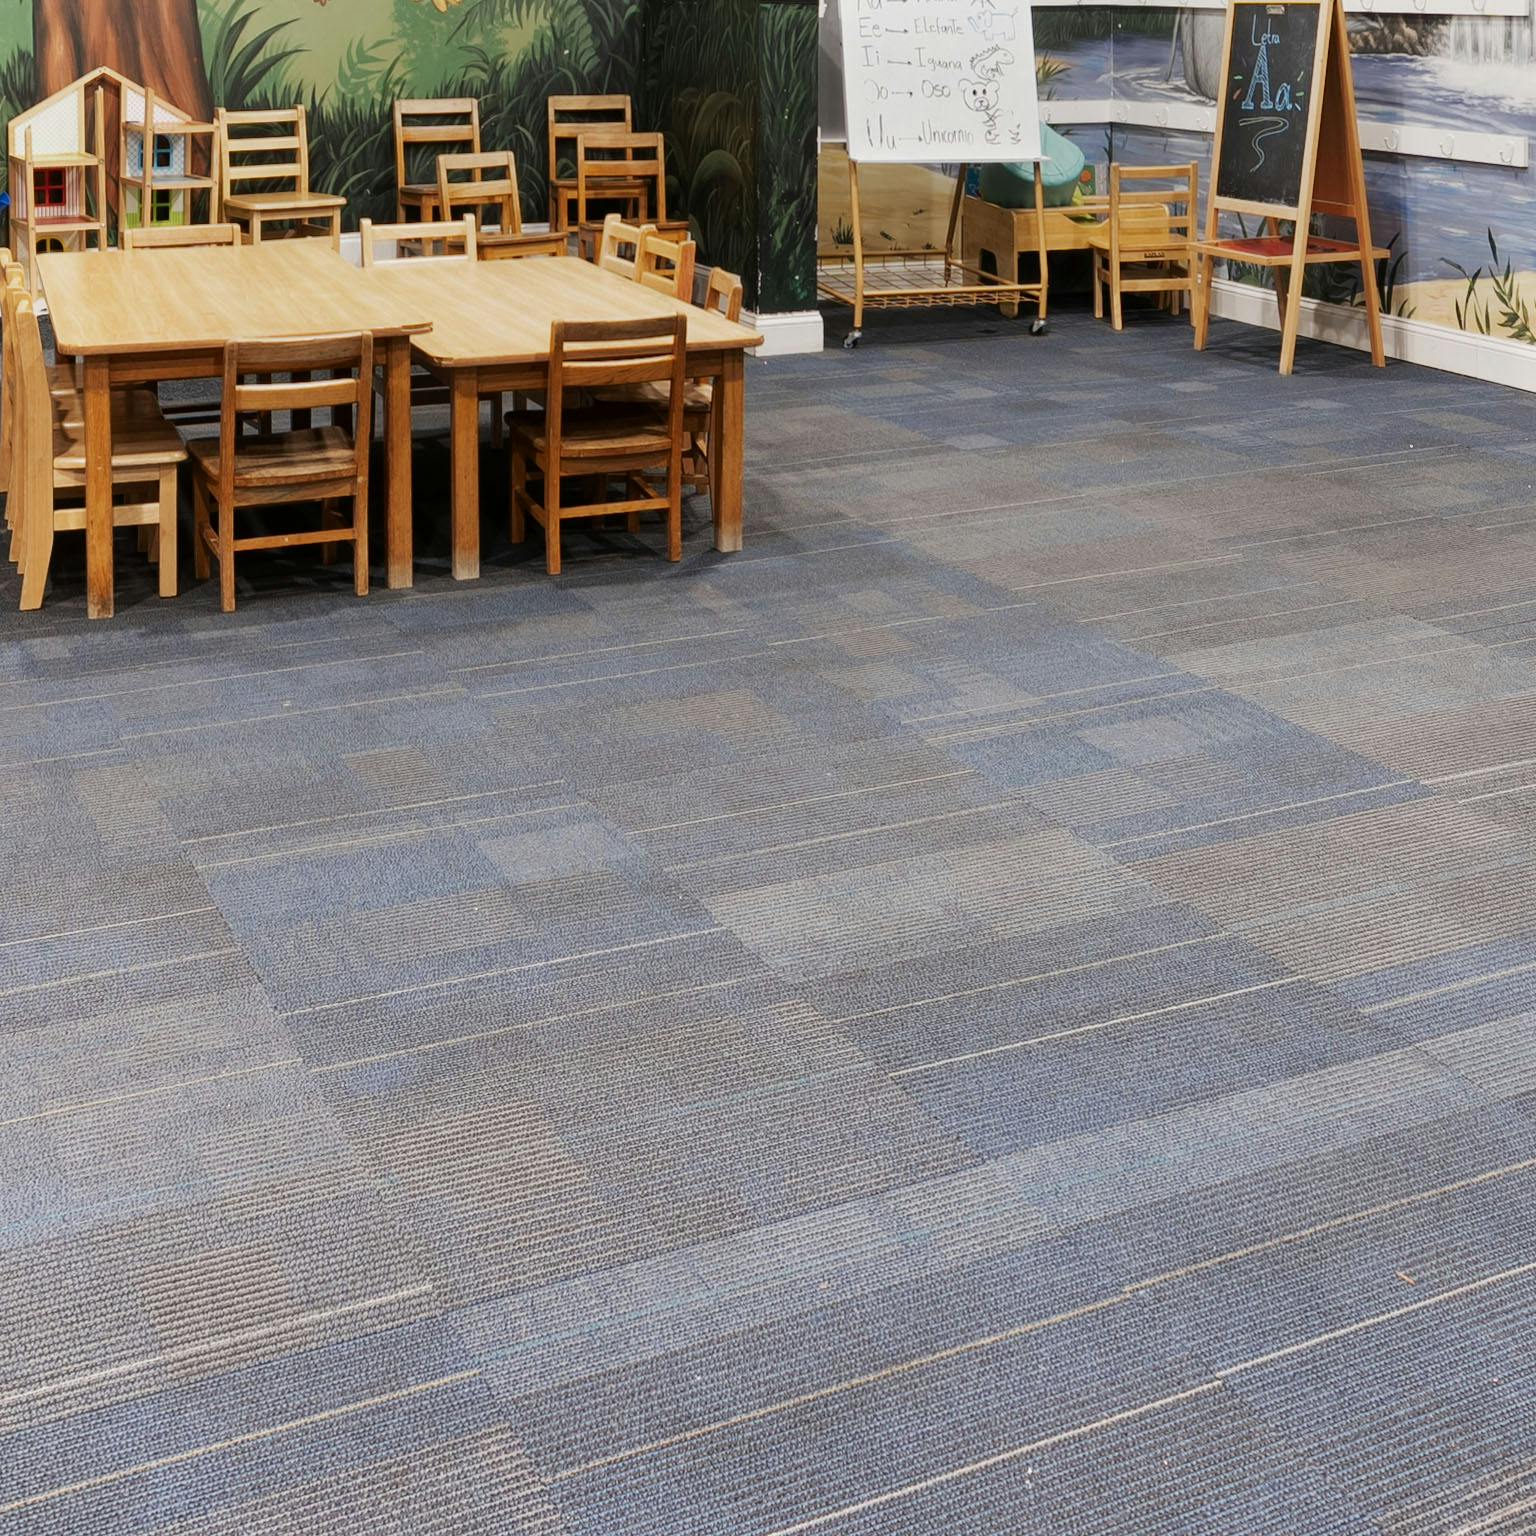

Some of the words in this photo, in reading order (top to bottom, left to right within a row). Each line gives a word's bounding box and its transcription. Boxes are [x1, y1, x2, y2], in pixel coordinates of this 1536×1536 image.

[859, 17, 882, 38] Ee
[1252, 13, 1281, 46] Letra
[861, 46, 880, 67] Ii
[915, 47, 963, 72] Iguana
[921, 79, 951, 98] Oso
[1241, 45, 1292, 111] Aa
[922, 119, 974, 145] Unicornio
